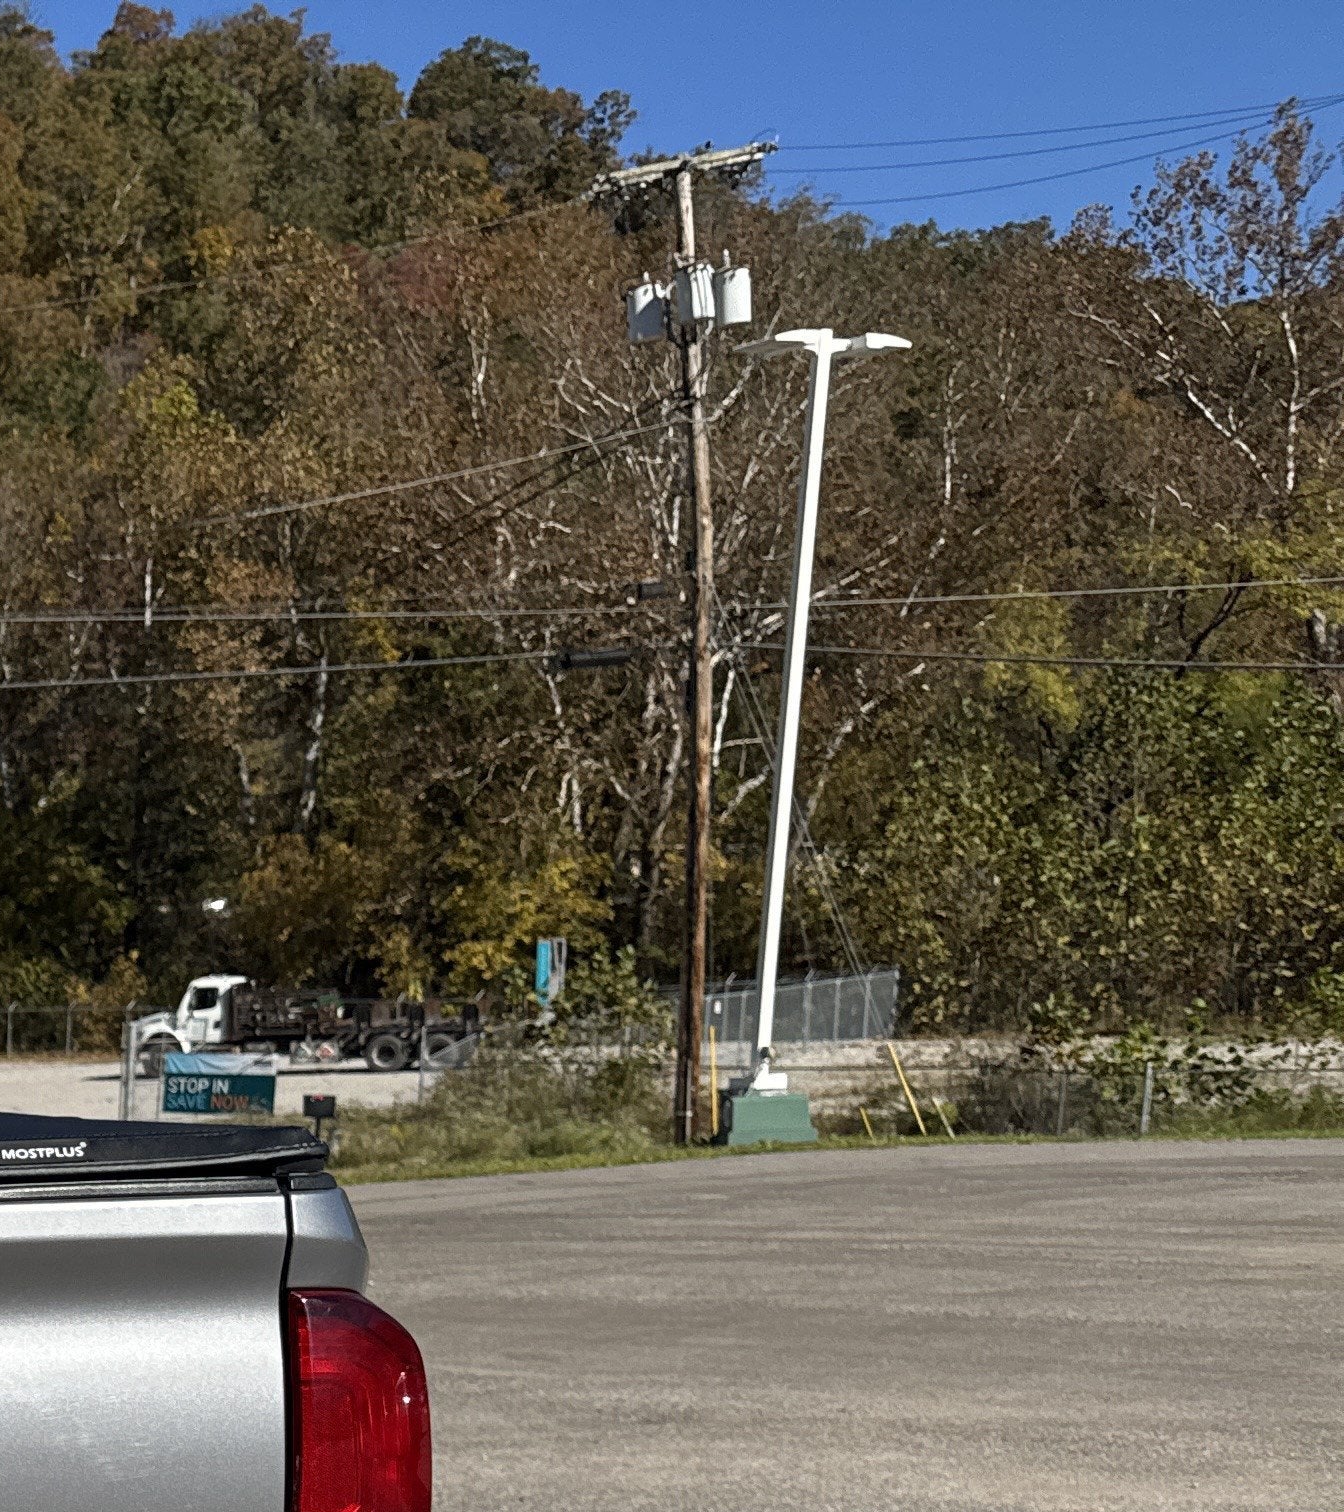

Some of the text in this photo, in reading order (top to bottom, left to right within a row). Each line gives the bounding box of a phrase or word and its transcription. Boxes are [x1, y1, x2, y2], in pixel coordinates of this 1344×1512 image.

[167, 1077, 230, 1095] STOP IN
[166, 1094, 249, 1111] SAVE NOW
[0, 1146, 85, 1160] MOSTPLUS
